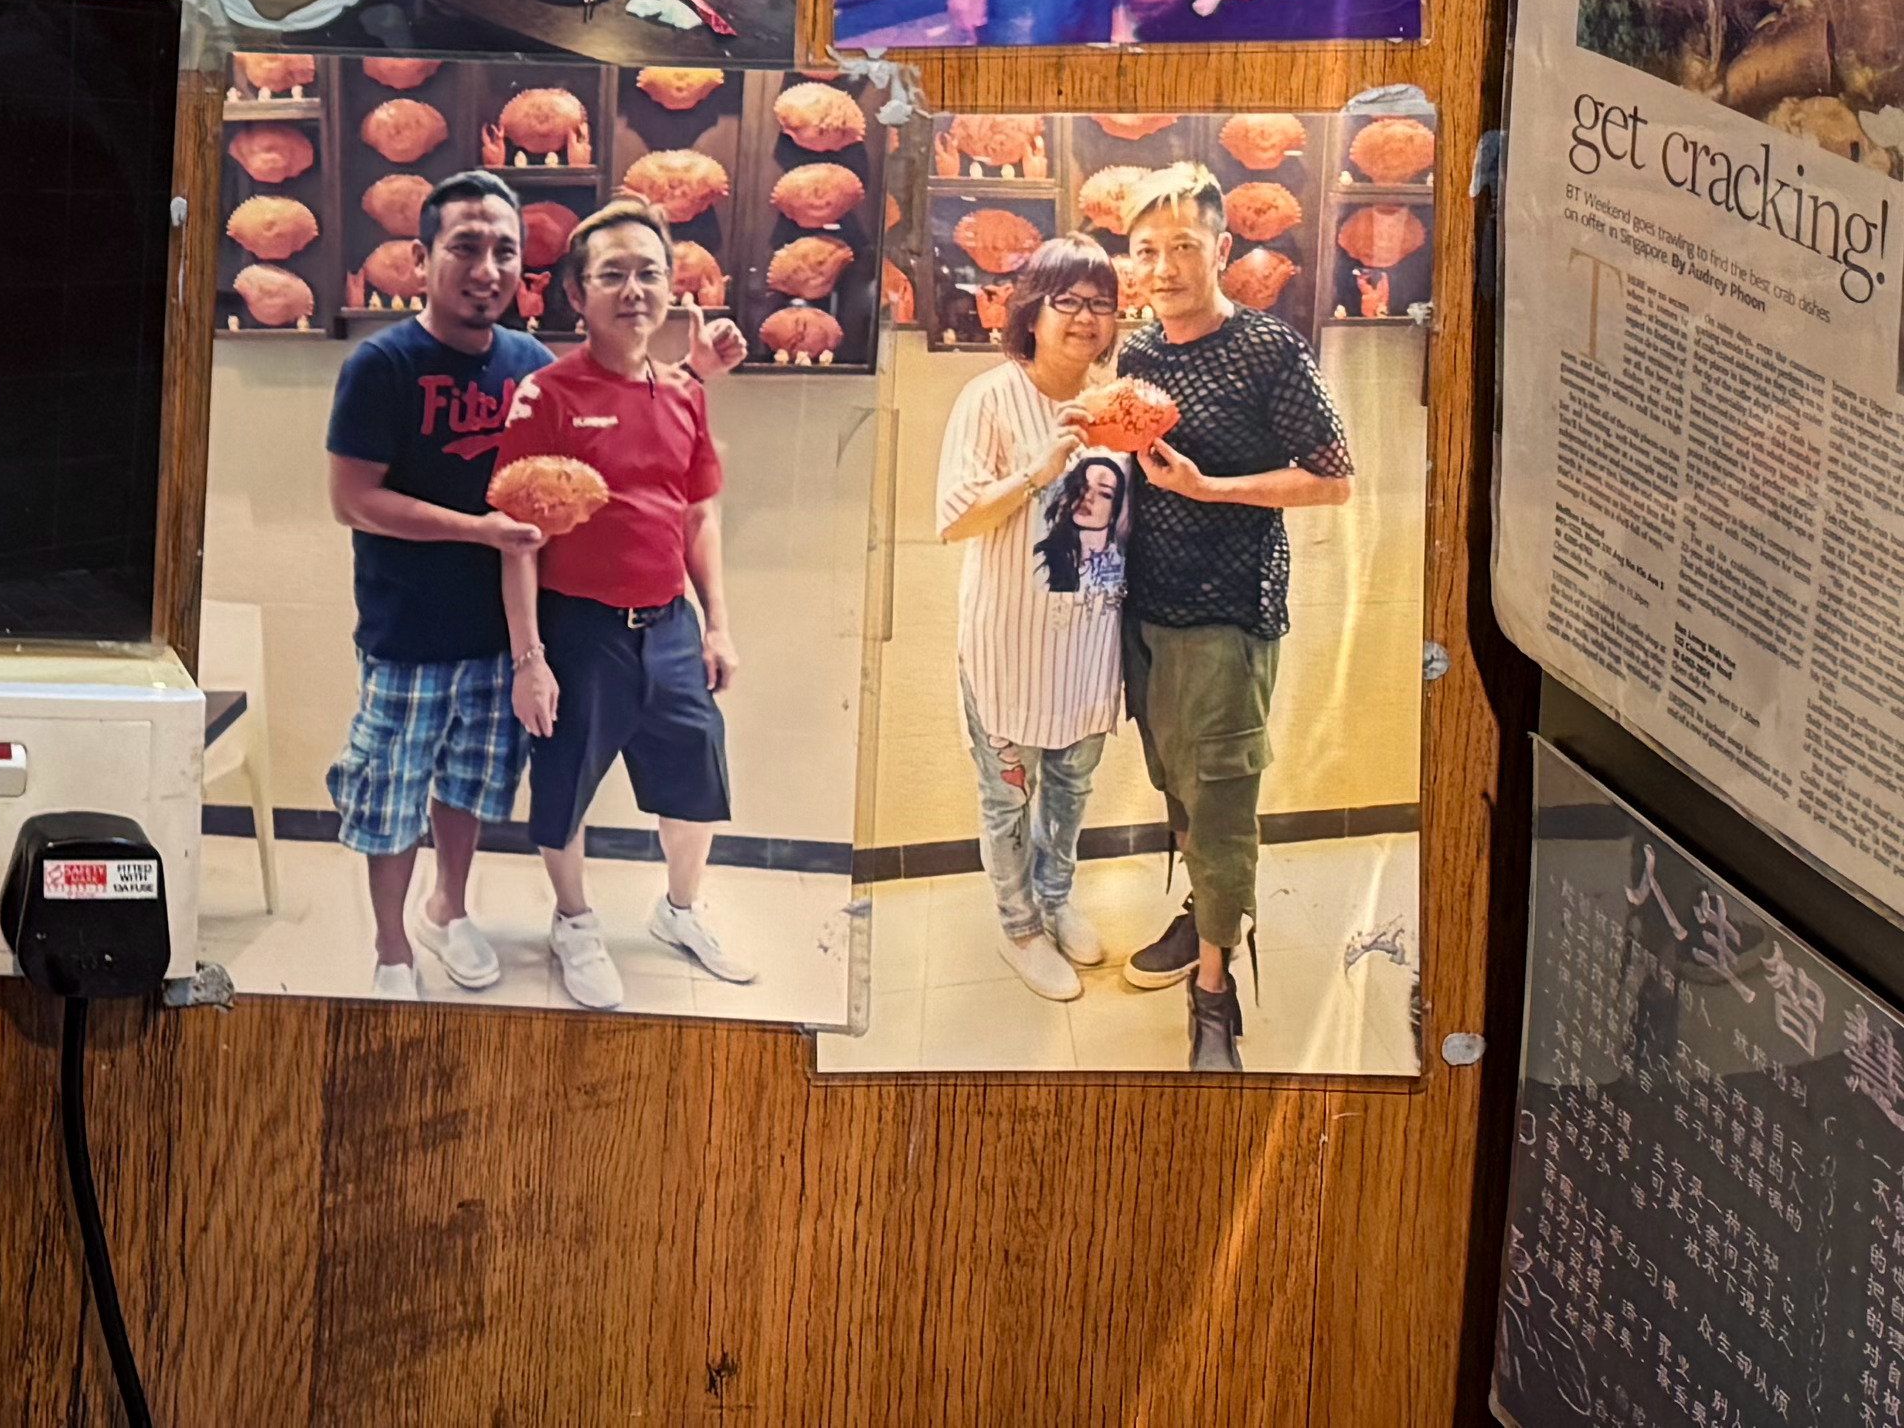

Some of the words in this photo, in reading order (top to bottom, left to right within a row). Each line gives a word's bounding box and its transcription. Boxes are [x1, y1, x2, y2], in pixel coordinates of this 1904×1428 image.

[1564, 206, 1578, 223] on
[1581, 210, 1606, 234] offer
[1670, 253, 1685, 277] By
[1688, 260, 1727, 298] Audrey
[1730, 282, 1766, 312] Phoon
[1565, 182, 1582, 204] BT
[1584, 190, 1630, 225] Weekend
[1632, 214, 1655, 239] goes
[1696, 244, 1708, 261] to
[1730, 259, 1747, 283] the
[1749, 268, 1770, 294] best
[1772, 282, 1796, 307] crab
[1798, 295, 1831, 324] dishes
[1568, 93, 1649, 175] get
[1661, 132, 1889, 305] cracking!
